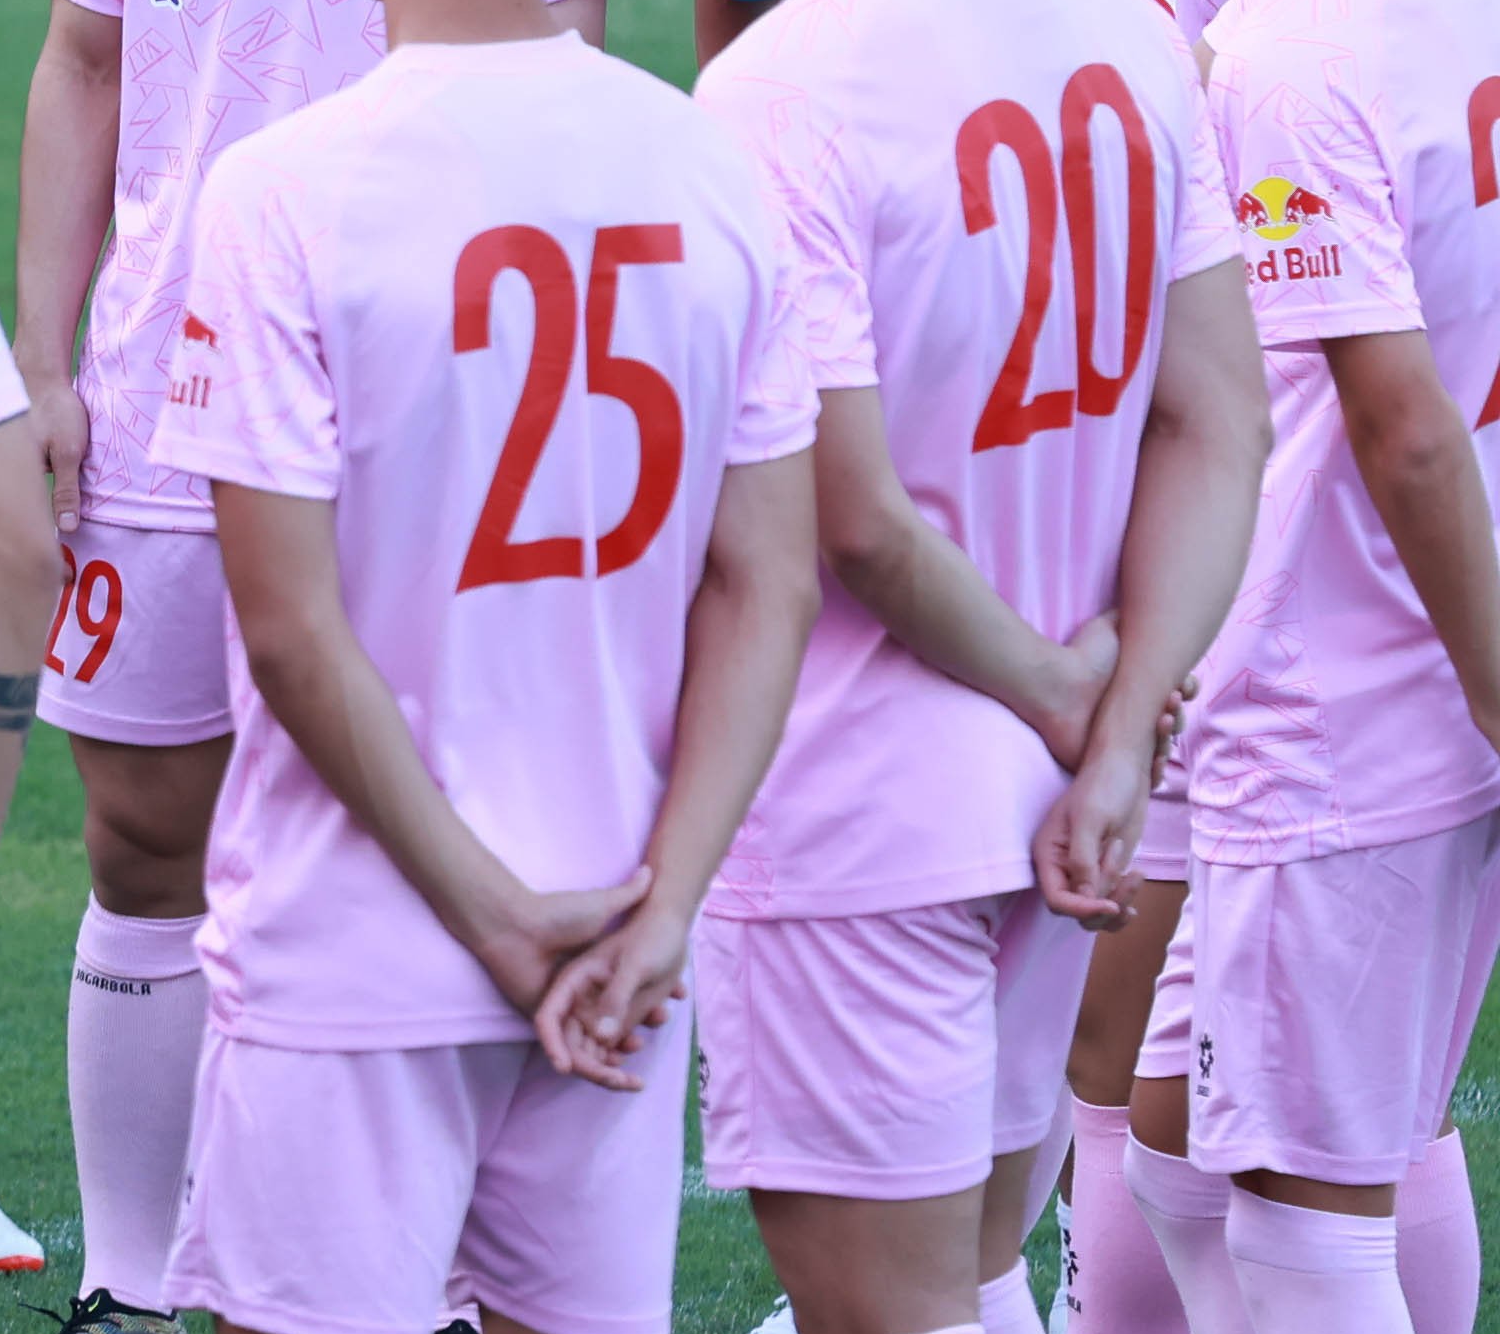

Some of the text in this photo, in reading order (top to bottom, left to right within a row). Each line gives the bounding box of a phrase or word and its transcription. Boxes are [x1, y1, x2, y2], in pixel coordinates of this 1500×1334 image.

[955, 63, 1157, 454] 20
[1284, 244, 1342, 280] Bull
[452, 223, 685, 593] 25
[75, 968, 153, 996] JOGARBOLA
